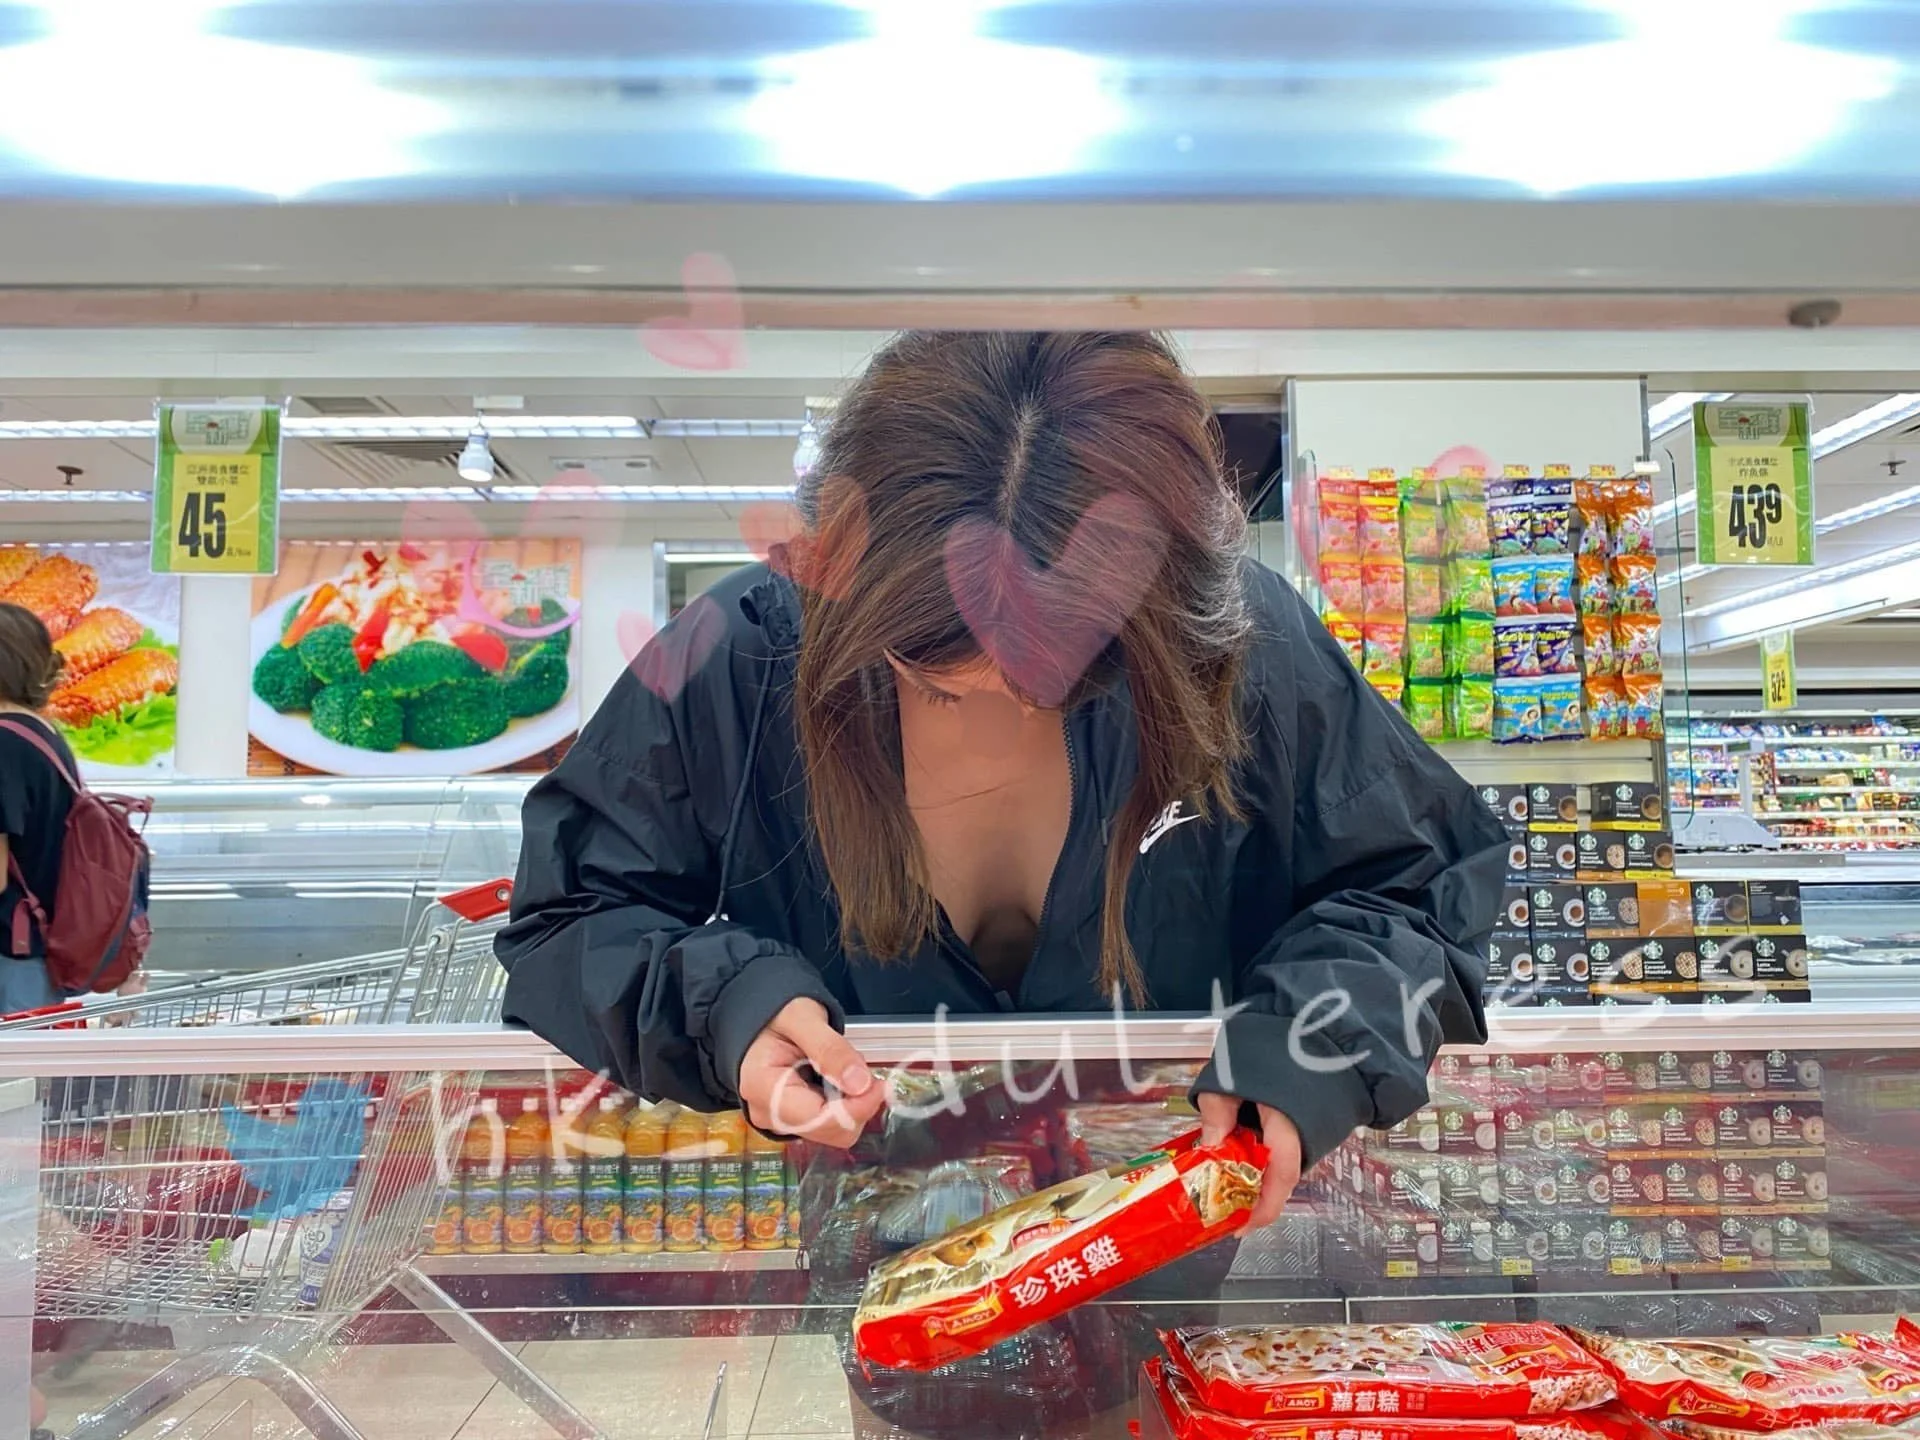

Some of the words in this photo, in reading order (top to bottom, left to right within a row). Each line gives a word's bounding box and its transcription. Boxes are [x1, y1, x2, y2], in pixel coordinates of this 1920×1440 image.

[178, 492, 227, 559] 45
[1008, 1234, 1125, 1310] 珍珠雞
[1287, 1398, 1318, 1408] AMOY
[1330, 1389, 1401, 1414] 蘿蔔糕
